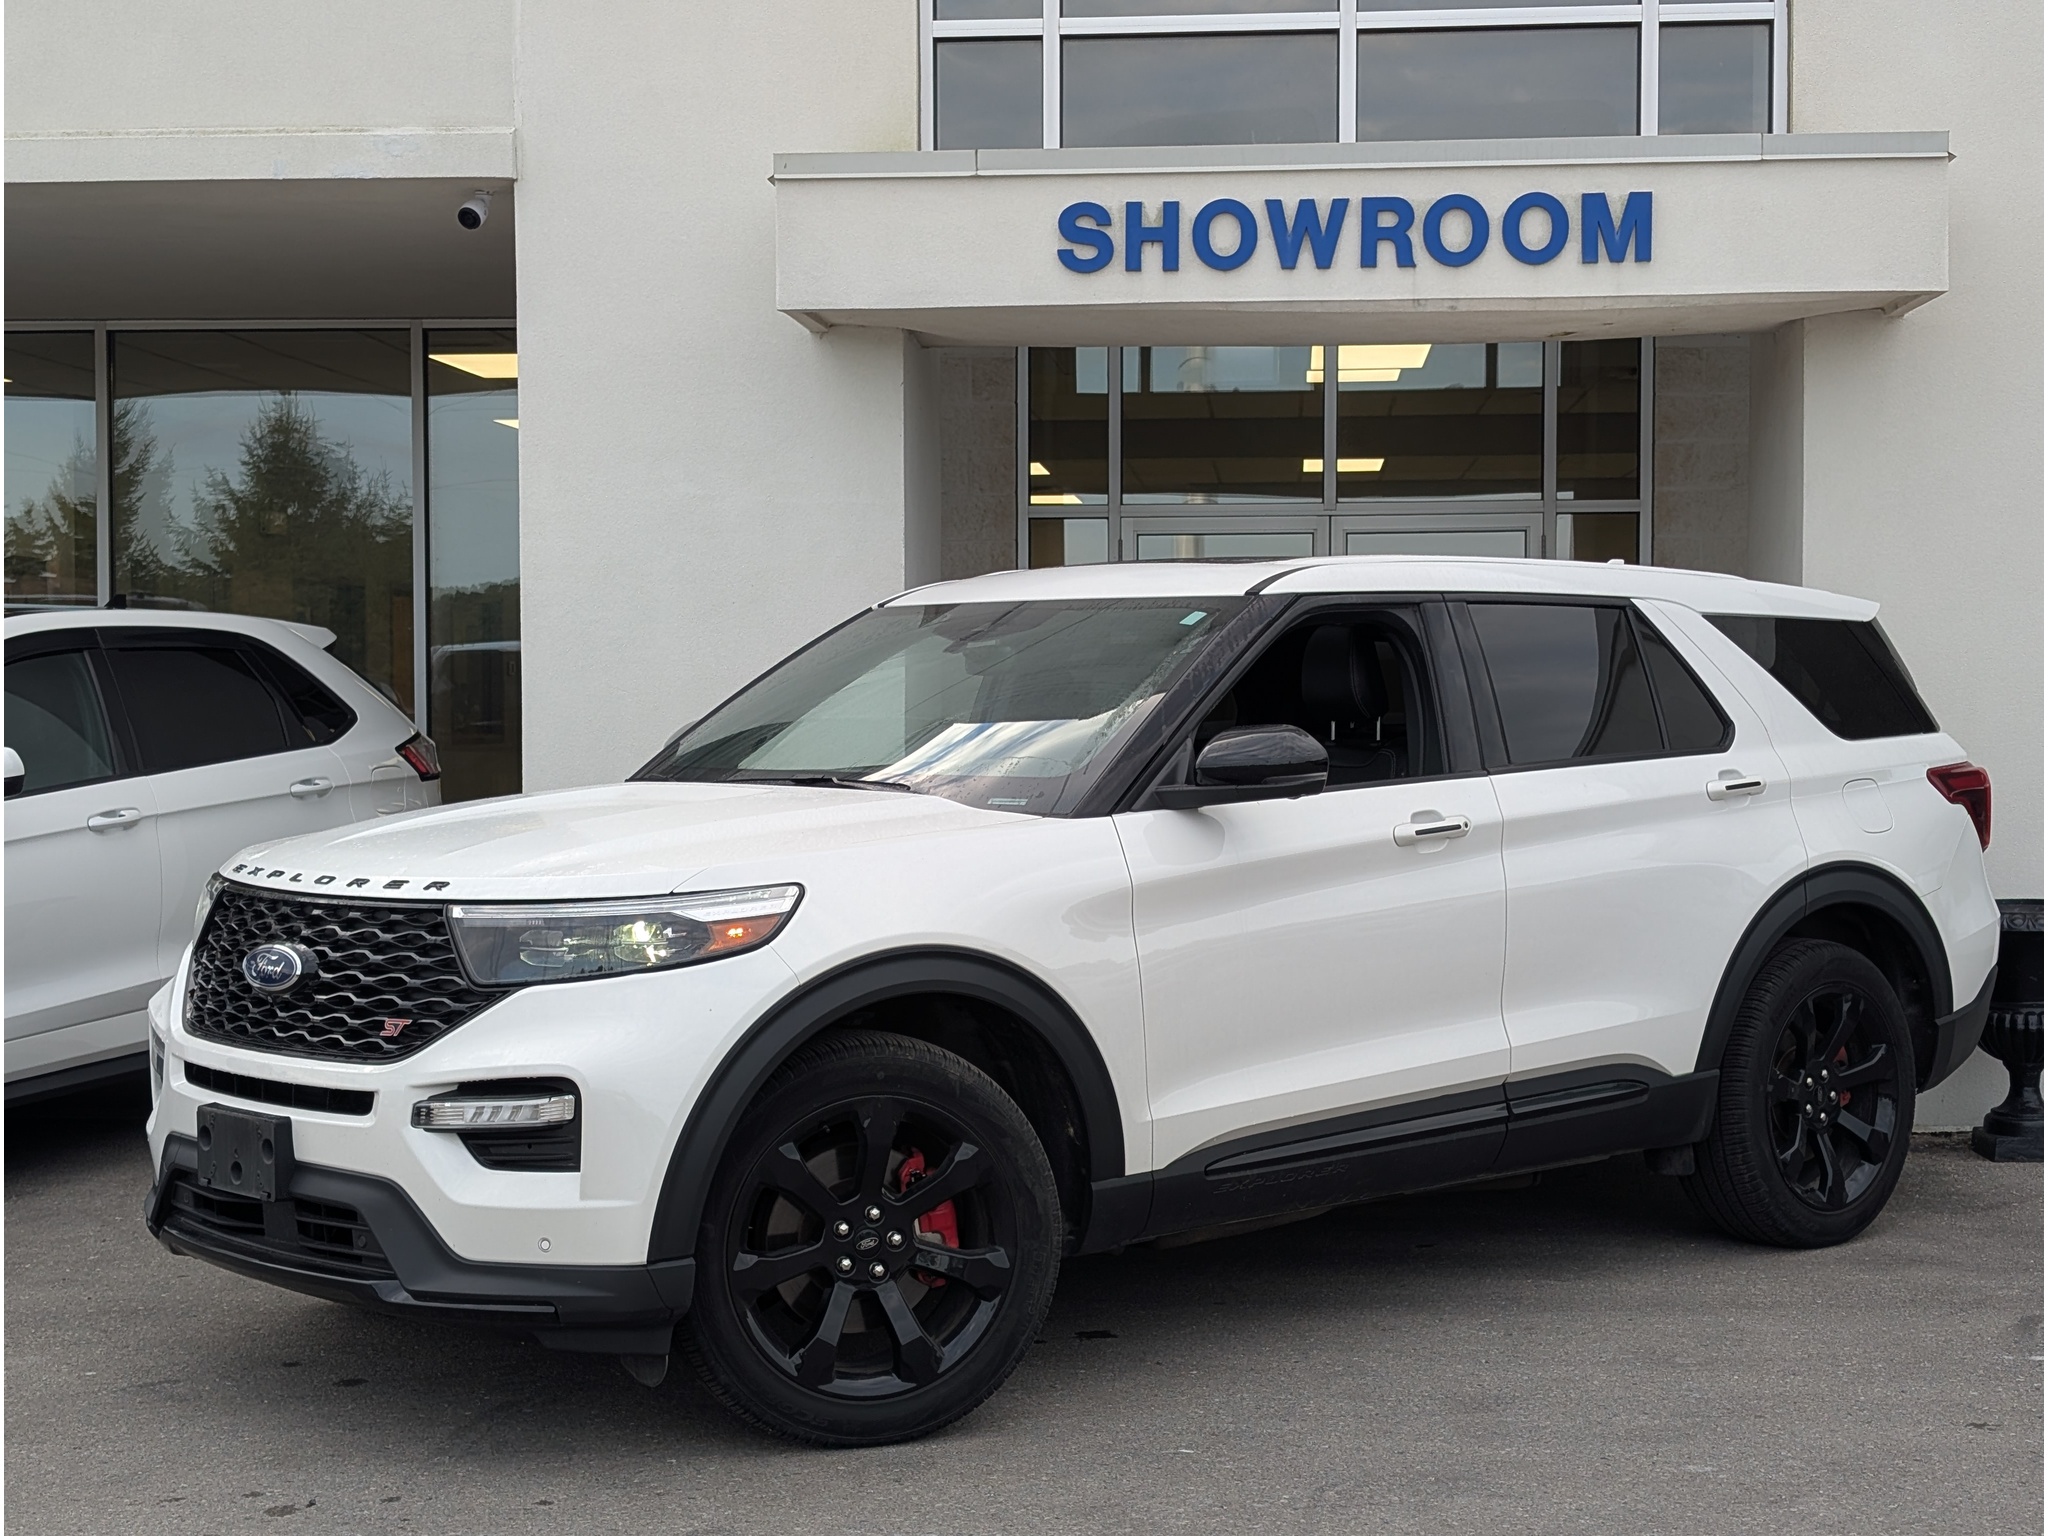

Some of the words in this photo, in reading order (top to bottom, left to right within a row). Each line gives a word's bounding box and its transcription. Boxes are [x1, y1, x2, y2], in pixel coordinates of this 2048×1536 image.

[1057, 191, 1653, 273] SHOWROOM
[232, 863, 451, 892] EXPLORER
[249, 952, 285, 980] Ford
[379, 1018, 413, 1037] ST
[1213, 1163, 1349, 1194] EXPLORER
